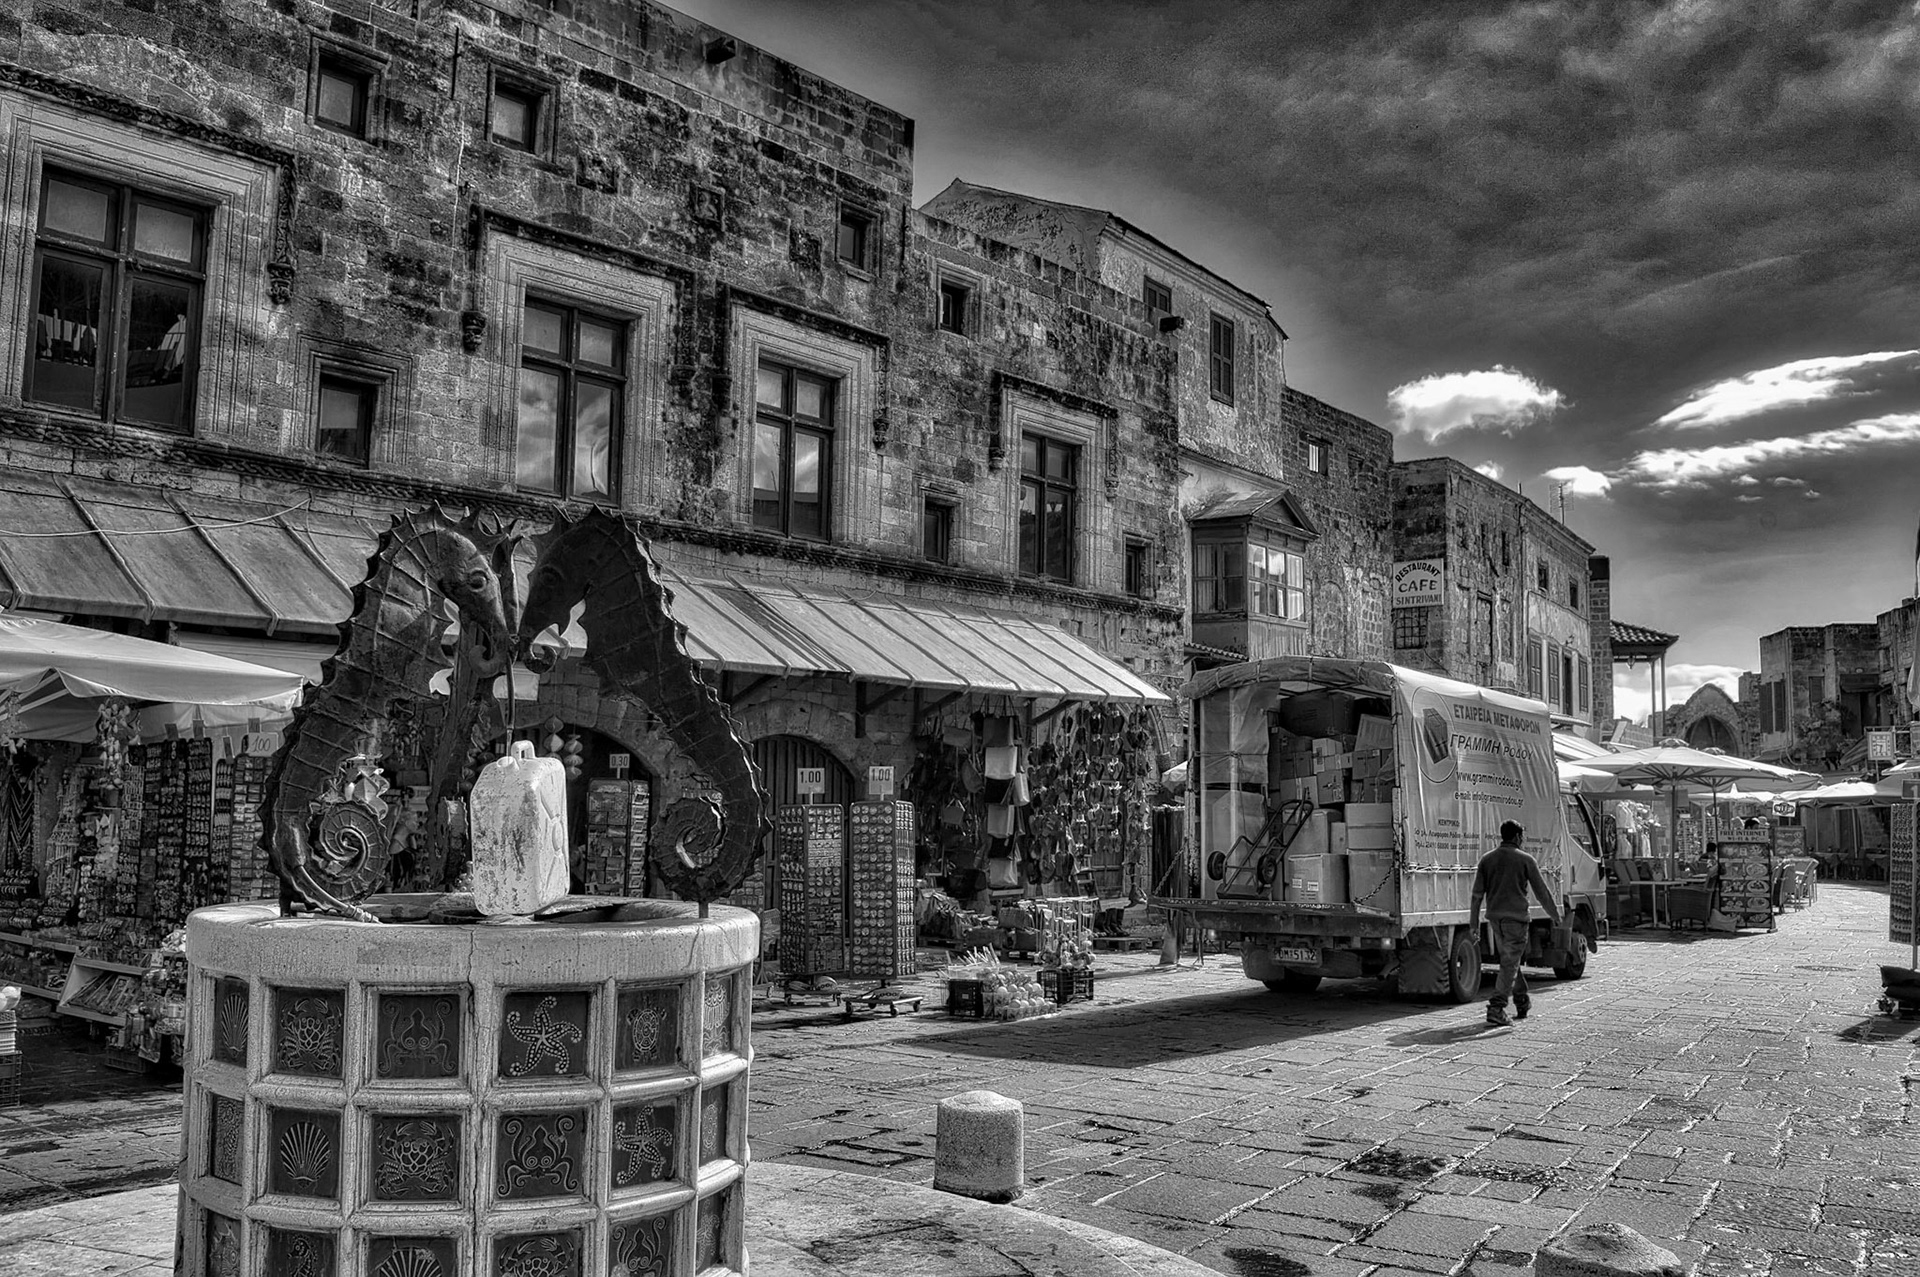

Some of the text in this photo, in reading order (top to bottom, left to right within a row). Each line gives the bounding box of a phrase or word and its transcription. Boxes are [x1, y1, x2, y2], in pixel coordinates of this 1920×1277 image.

[1395, 562, 1441, 582] RESTAURANT
[1398, 579, 1438, 593] CAFE
[1396, 594, 1442, 606] SINTRIVANI
[1453, 704, 1541, 735] ΕΤΑΙΡΕΙΑ ΜΕΤΑΦΟΡΩΝ
[1450, 733, 1534, 761] ΓΡΑΜΜΗ ΡΟΔΟΥ
[800, 770, 821, 784] 1.00
[871, 768, 891, 782] 1.00
[1456, 772, 1522, 791] www.grammirodou.gr
